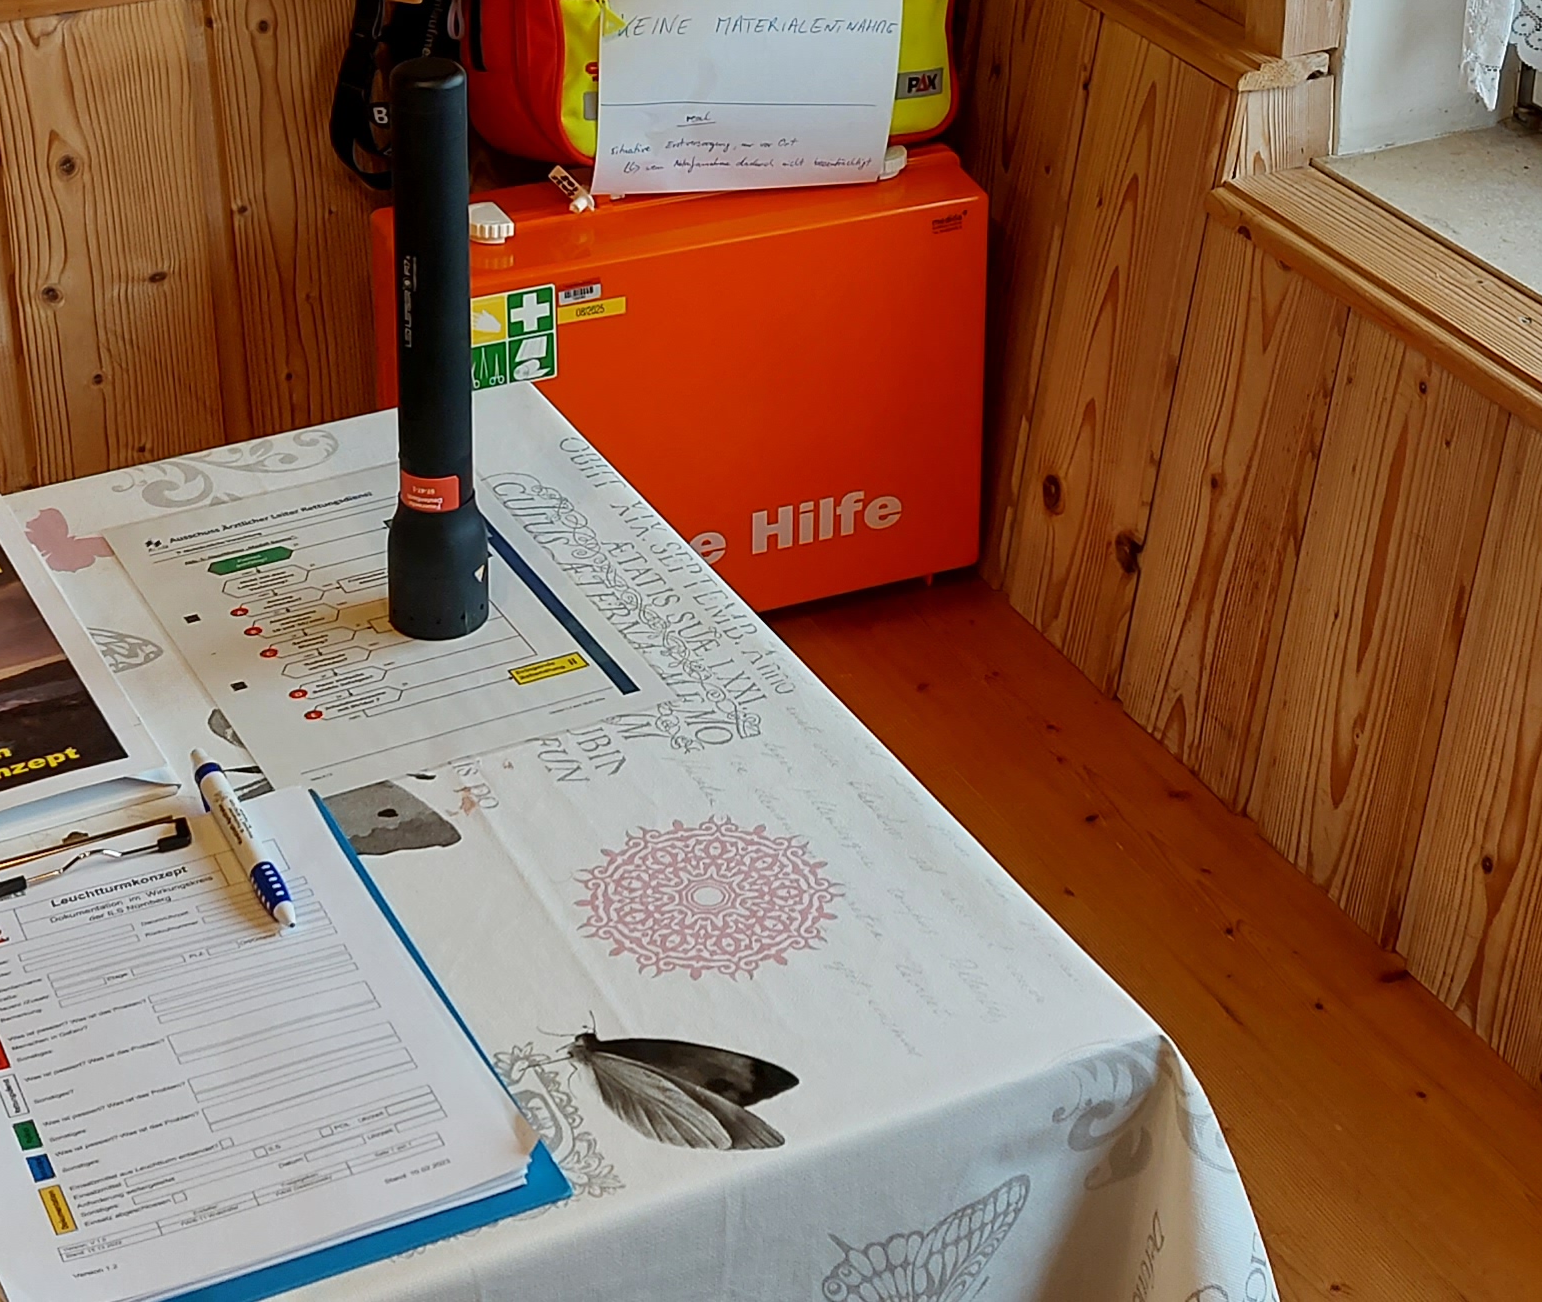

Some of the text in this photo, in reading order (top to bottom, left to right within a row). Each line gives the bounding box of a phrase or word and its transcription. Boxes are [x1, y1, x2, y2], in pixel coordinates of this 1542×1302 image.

[618, 14, 899, 39] KEINE MATERIALENTNAHME
[907, 72, 938, 94] PAX
[167, 526, 221, 543] Ausschuss
[218, 514, 271, 531] Ärztlicher
[268, 508, 301, 519] Leiter
[752, 490, 902, 555] Hilfe
[48, 898, 124, 924] Dokumentation
[127, 894, 142, 903] im
[144, 874, 214, 898] Wirkungskreis
[49, 864, 189, 909] Leuchtturmkonzept
[125, 894, 172, 912] Nürnberg
